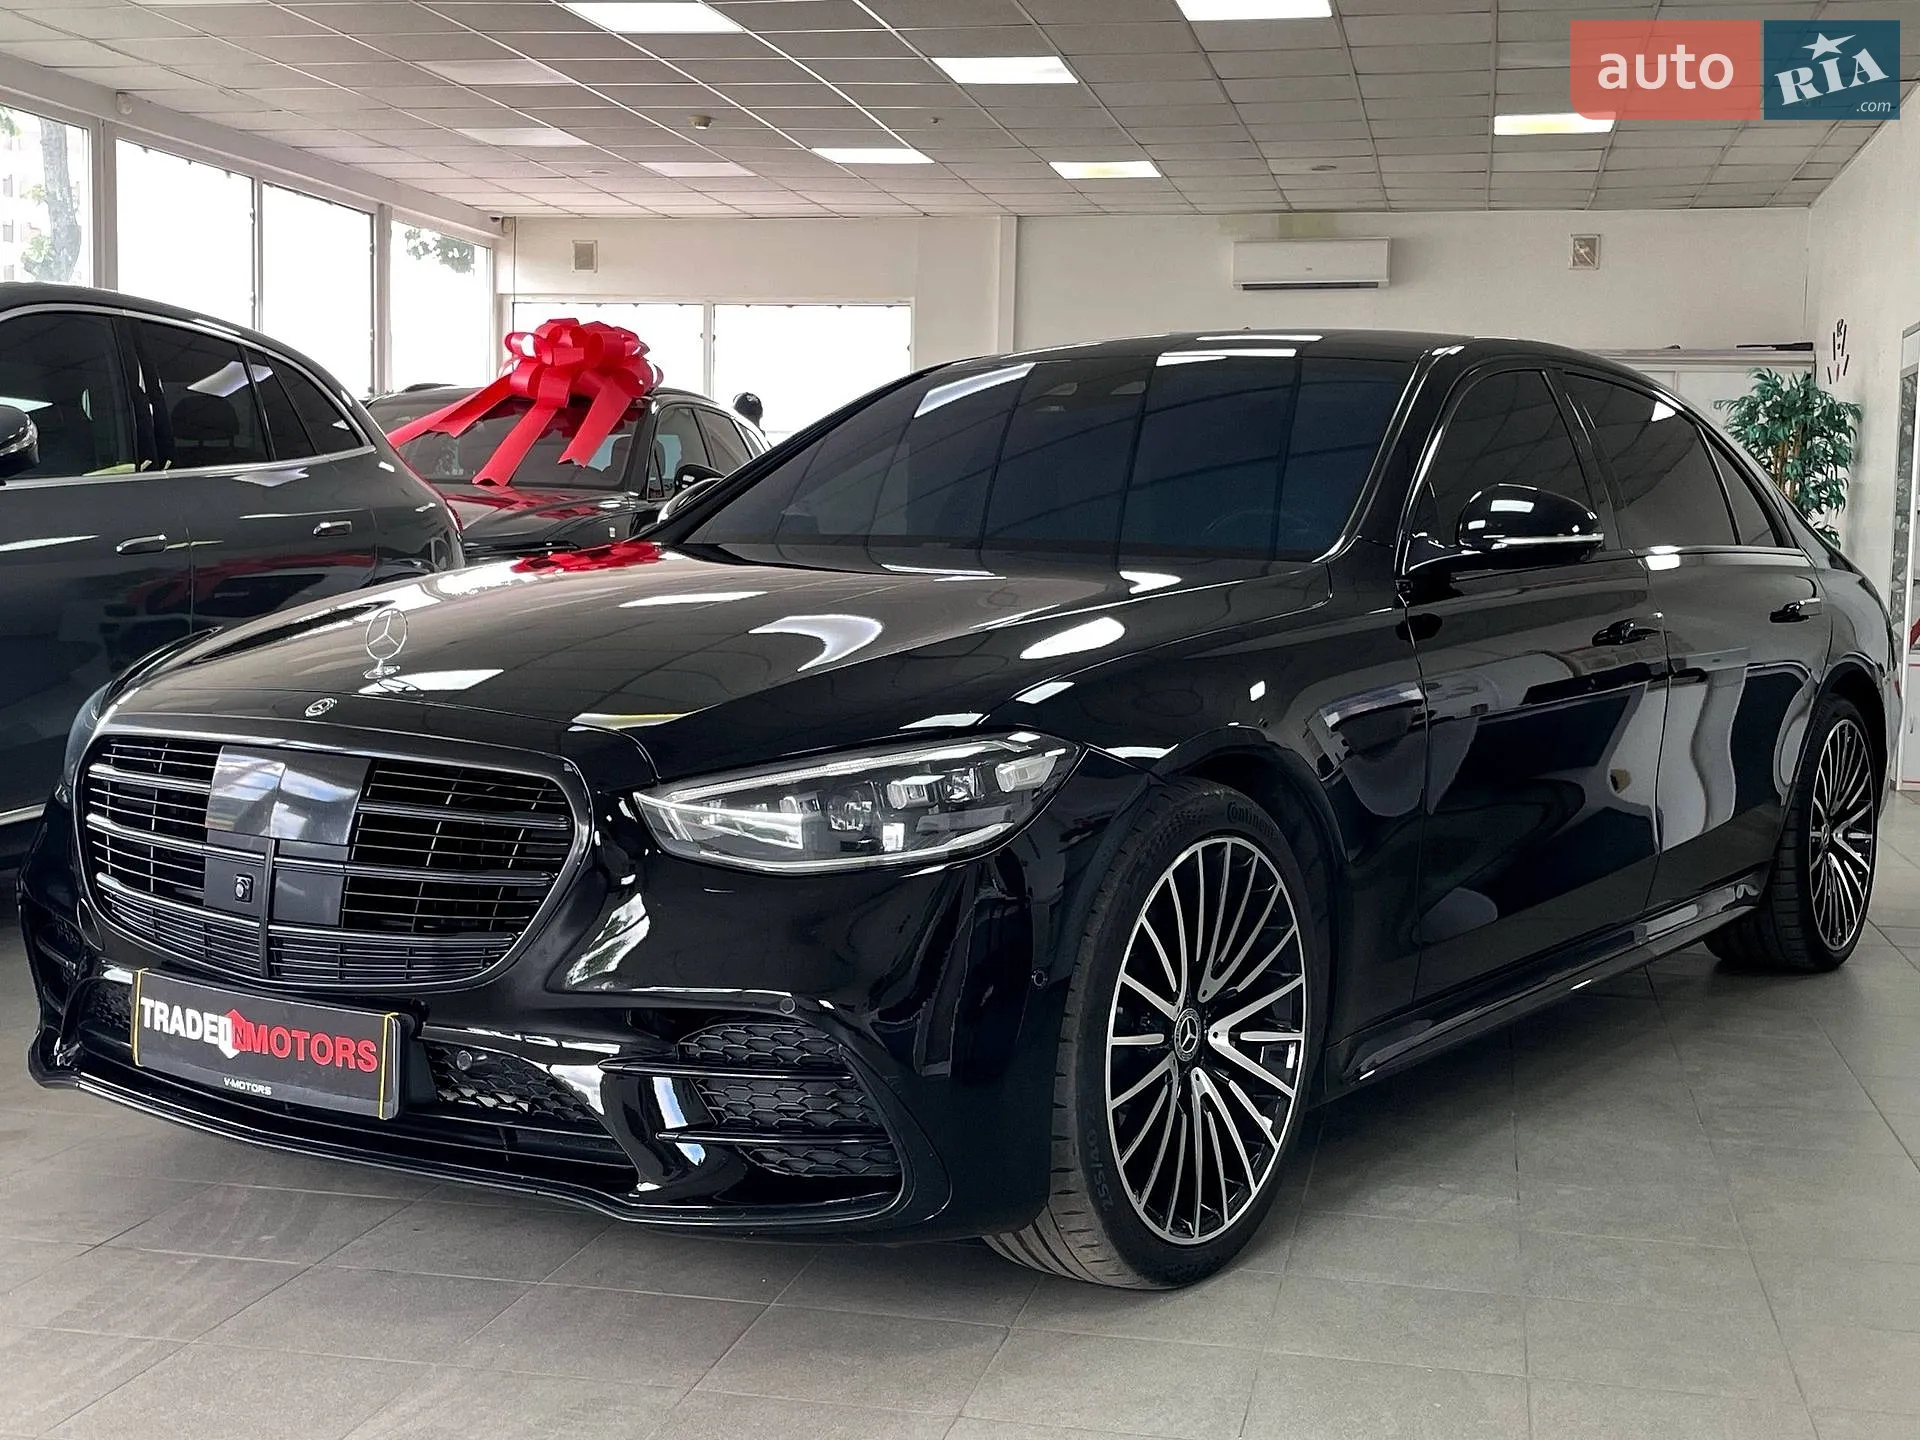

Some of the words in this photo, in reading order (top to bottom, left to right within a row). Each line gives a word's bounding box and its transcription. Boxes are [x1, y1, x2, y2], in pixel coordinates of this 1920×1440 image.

[141, 997, 218, 1045] TRADE
[246, 1021, 378, 1073] MOTORS
[223, 1077, 272, 1096] V-MOTORS
